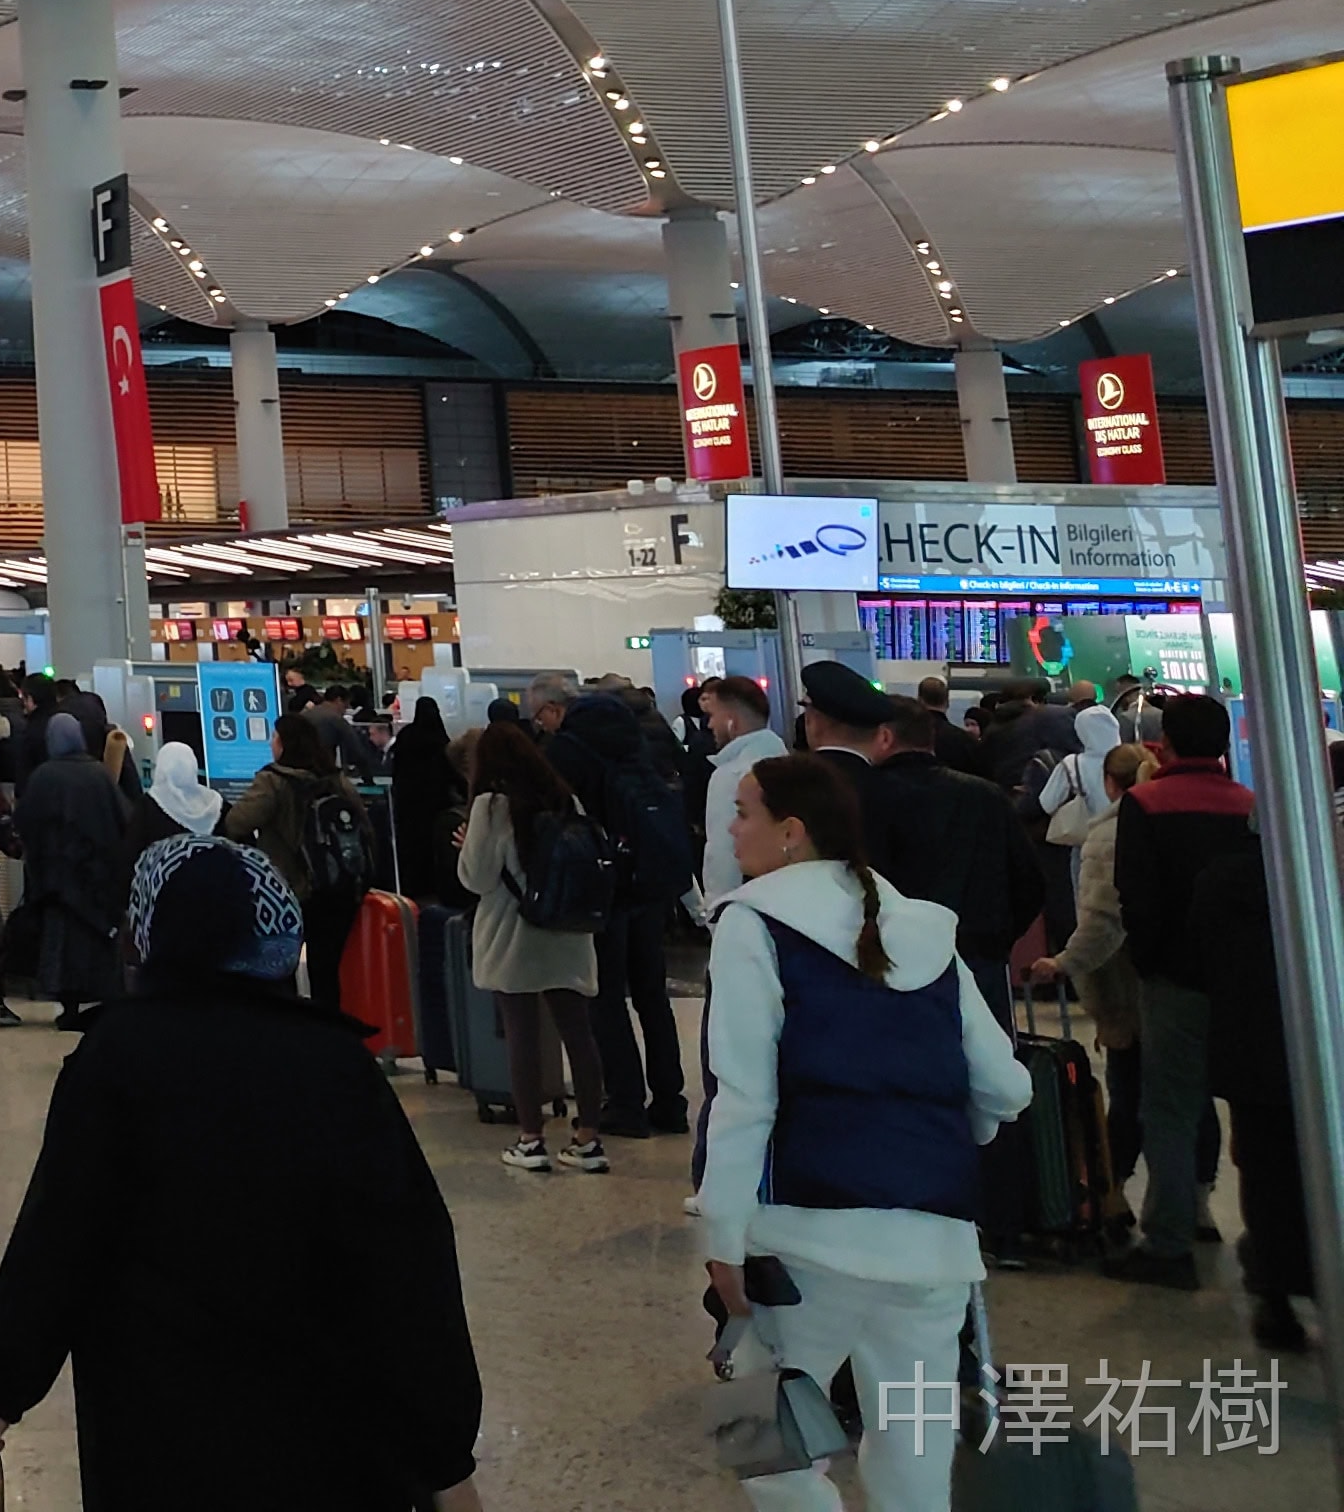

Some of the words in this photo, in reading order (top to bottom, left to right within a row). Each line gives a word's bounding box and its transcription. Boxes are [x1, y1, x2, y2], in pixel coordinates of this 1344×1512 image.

[96, 190, 112, 261] F
[1087, 413, 1150, 430] INTERNATIONAL
[1107, 427, 1141, 442] HATLAR
[1121, 444, 1143, 455] CLASS
[670, 514, 688, 565] F
[878, 522, 1061, 565] HECK-IN
[1067, 524, 1133, 546] Bilgileri
[629, 548, 657, 567] 1-22
[1070, 548, 1176, 567] Information
[1163, 581, 1181, 593] A-E
